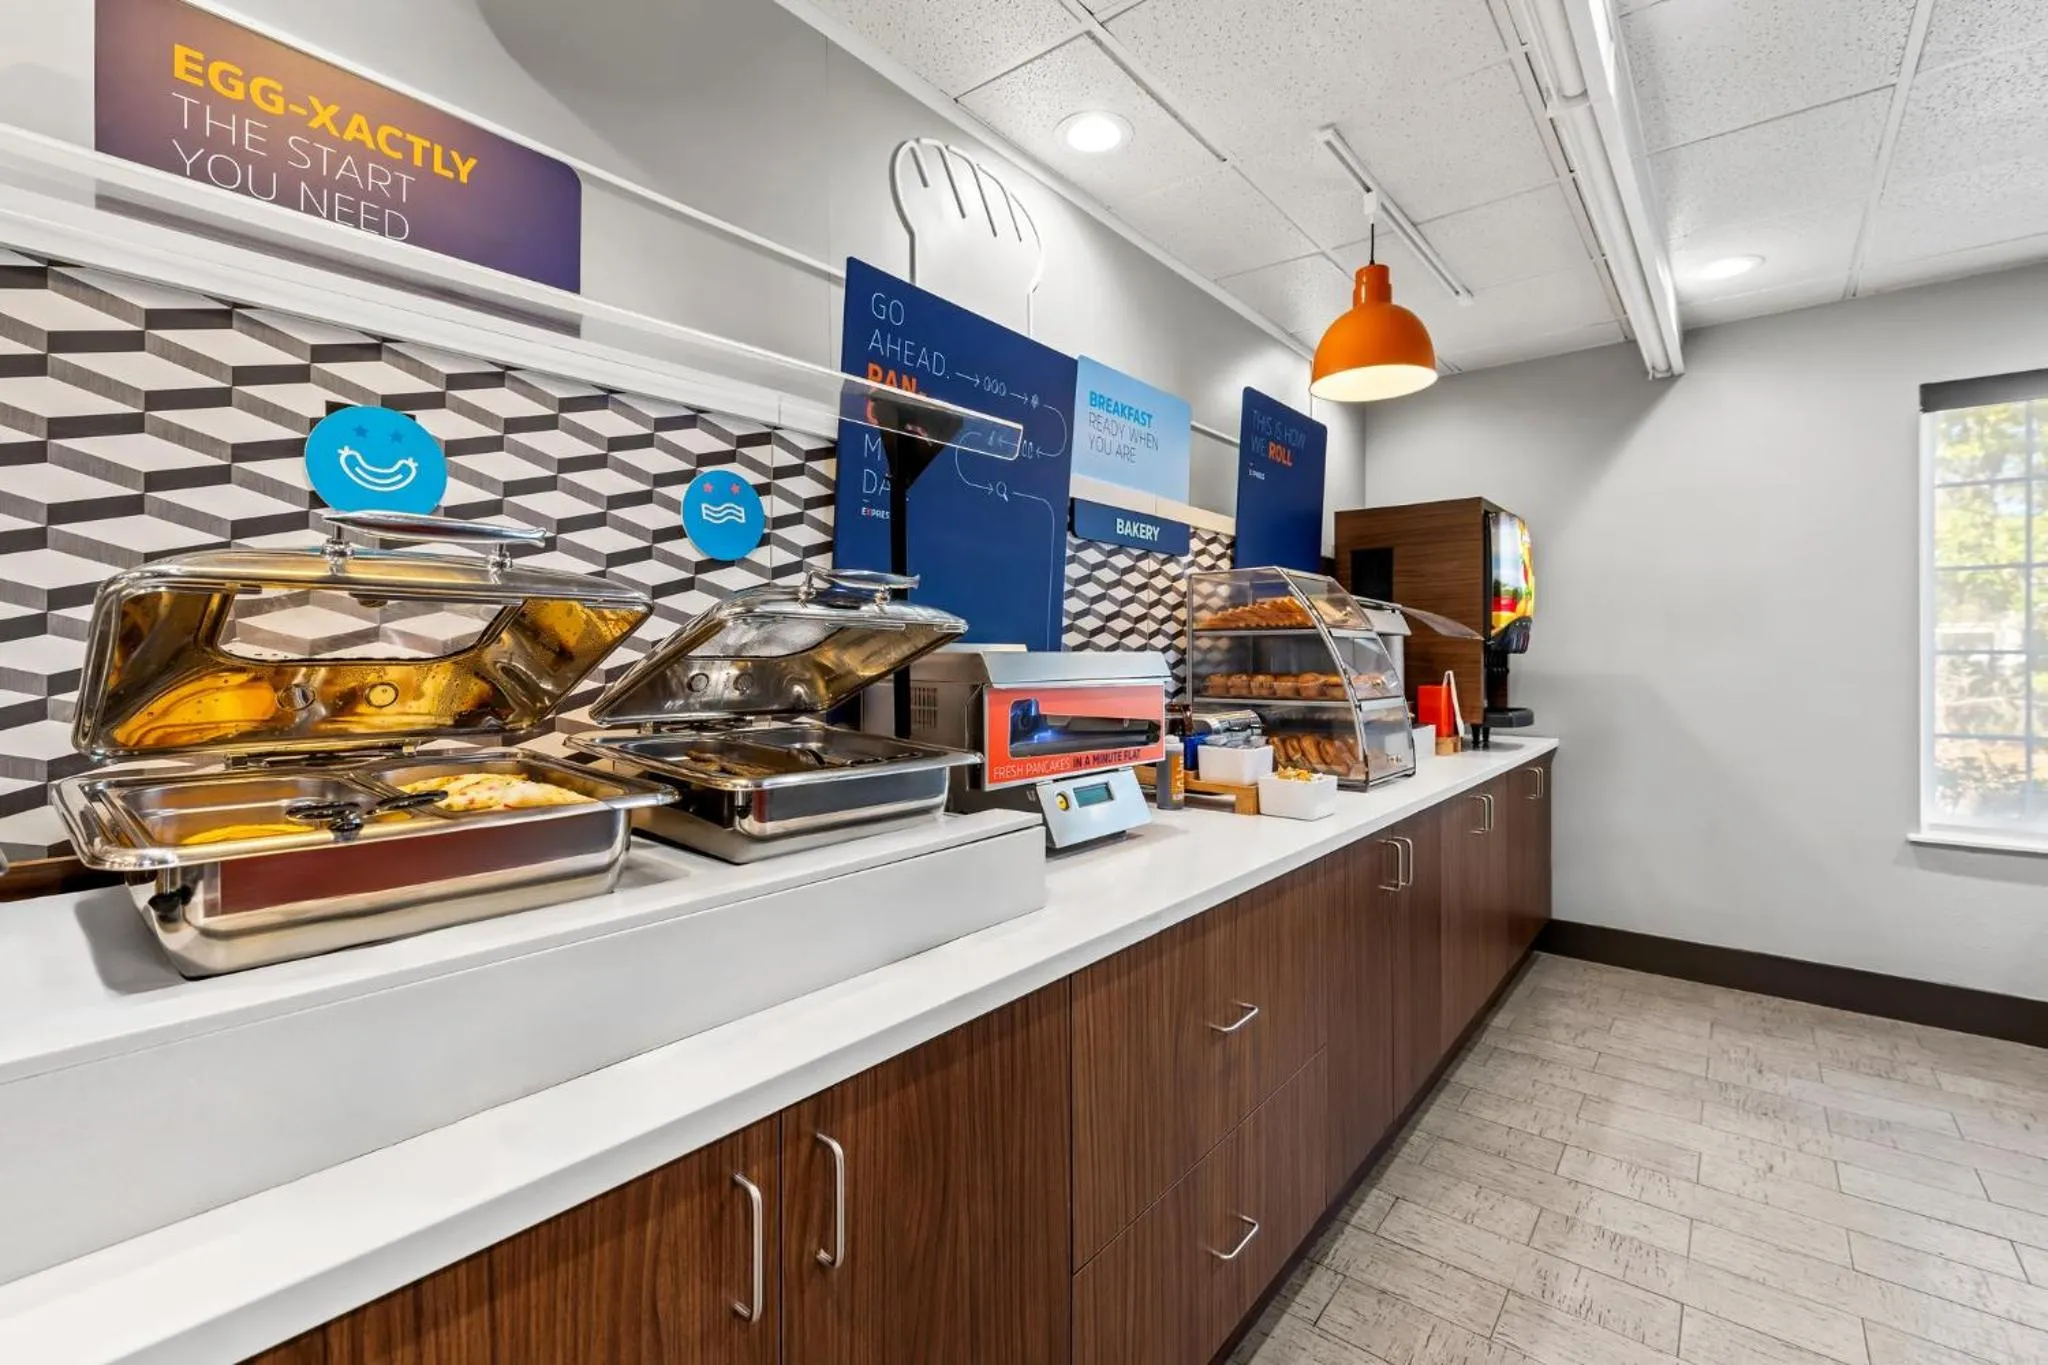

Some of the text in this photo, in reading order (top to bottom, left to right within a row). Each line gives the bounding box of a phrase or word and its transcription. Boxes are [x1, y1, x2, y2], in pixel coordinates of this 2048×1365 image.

[173, 43, 478, 185] EGG-XACTLY
[171, 91, 416, 204] THE START
[171, 138, 409, 242] YOU NEED
[871, 292, 905, 326] GO
[868, 328, 950, 379] AHEAD.
[1088, 390, 1153, 429] BREAKFAST
[1088, 411, 1159, 452] READY WHEN
[1088, 434, 1137, 464] YOU ARE
[1267, 440, 1293, 467] ROLL
[1116, 517, 1160, 542] BAKERY
[993, 749, 1141, 780] FRESH PANCAKES IN A MINUTE FLAT
